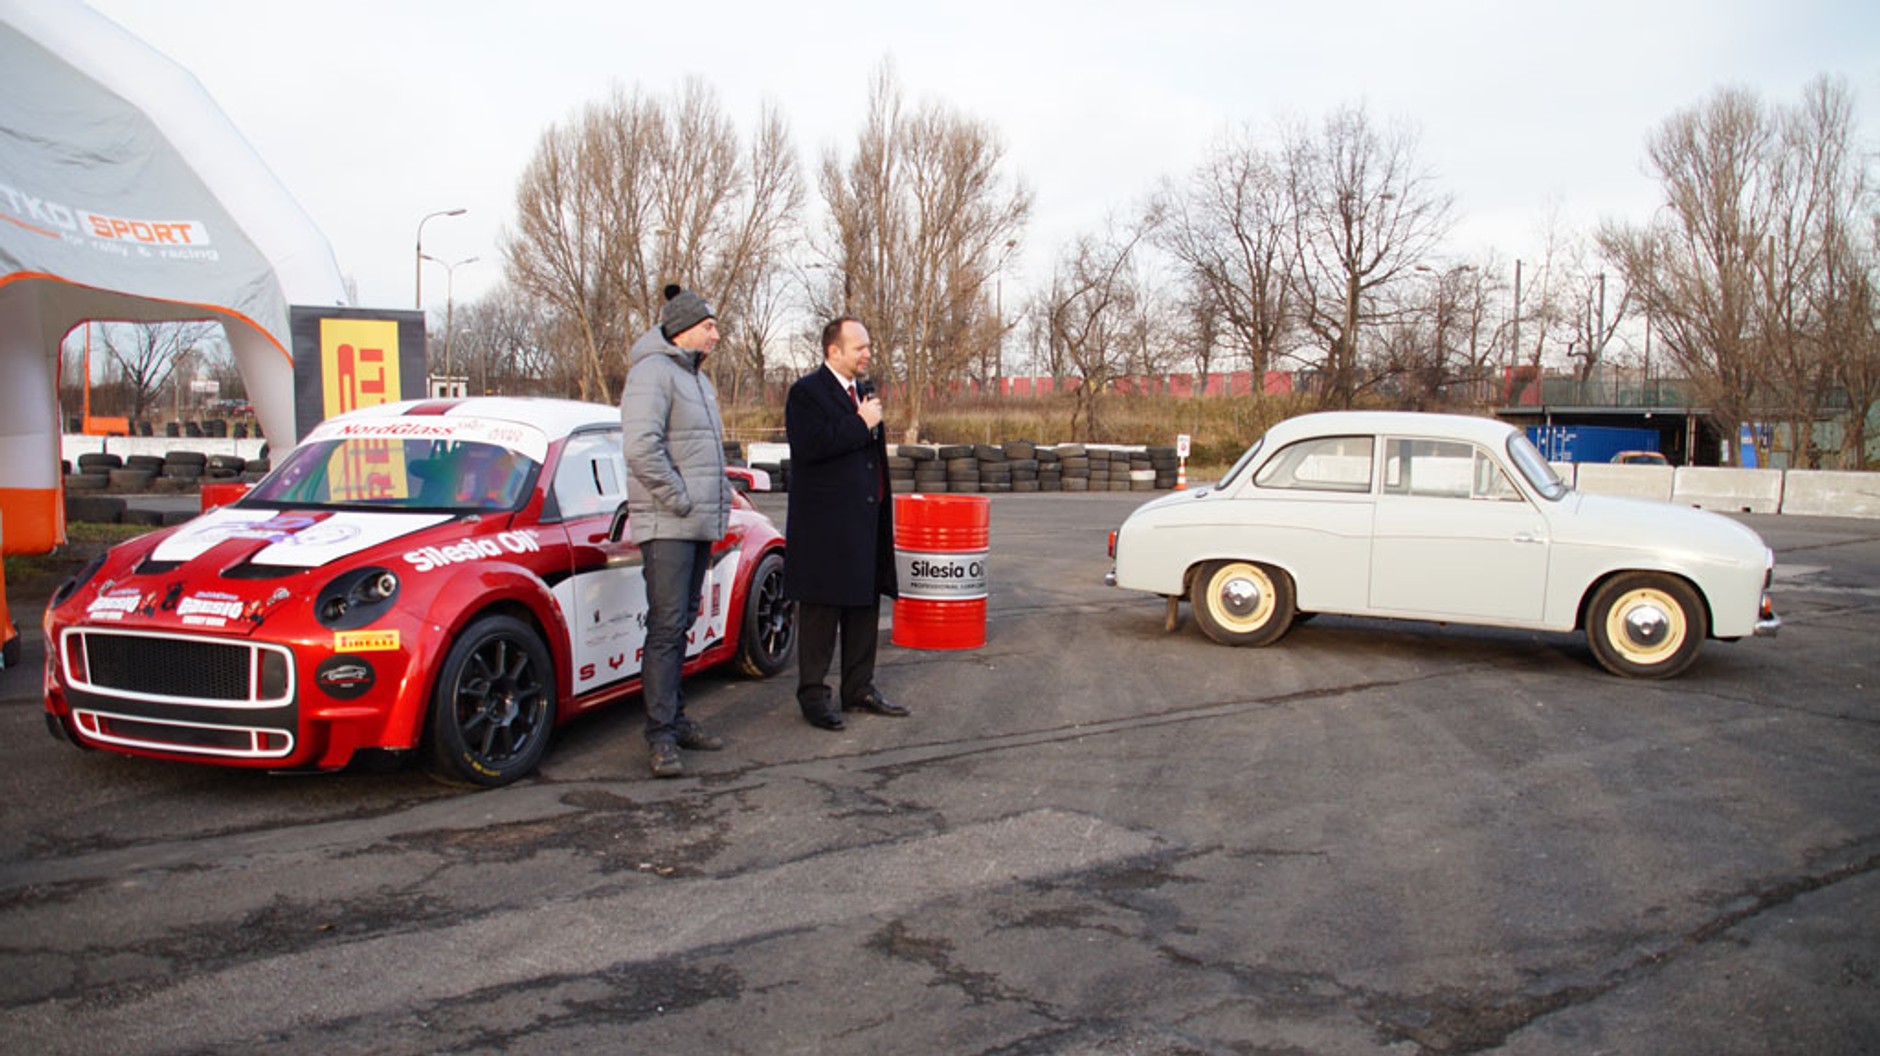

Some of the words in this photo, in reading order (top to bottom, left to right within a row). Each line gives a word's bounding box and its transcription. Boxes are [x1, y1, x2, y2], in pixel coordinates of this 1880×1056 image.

[88, 214, 191, 243] SPORT
[160, 248, 219, 261] racing
[403, 538, 502, 572] Silesia
[497, 529, 540, 554] Oil
[911, 560, 964, 578] Silesia
